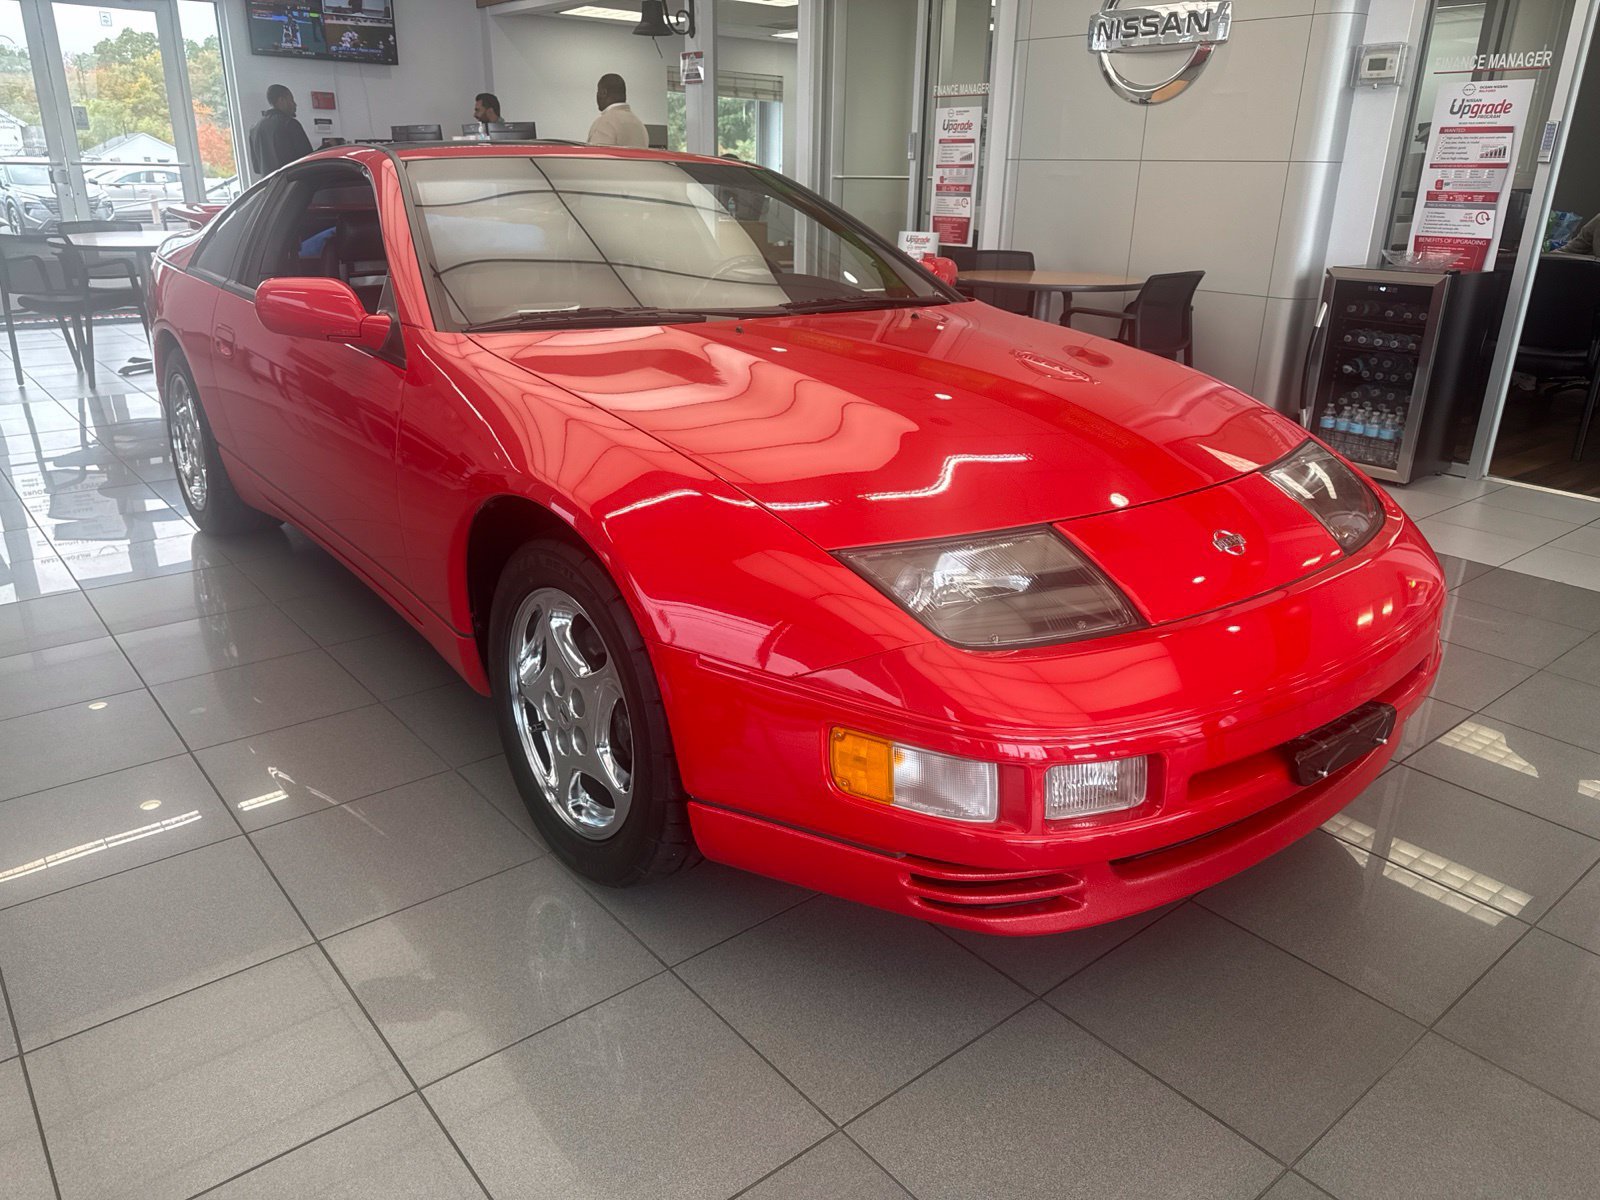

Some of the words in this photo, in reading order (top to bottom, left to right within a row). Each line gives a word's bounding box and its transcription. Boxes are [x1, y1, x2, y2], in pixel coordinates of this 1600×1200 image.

[1097, 9, 1213, 41] NISSAN
[1488, 50, 1553, 68] MANAGER
[1449, 98, 1513, 119] Upgrade
[942, 119, 973, 134] Upgrade
